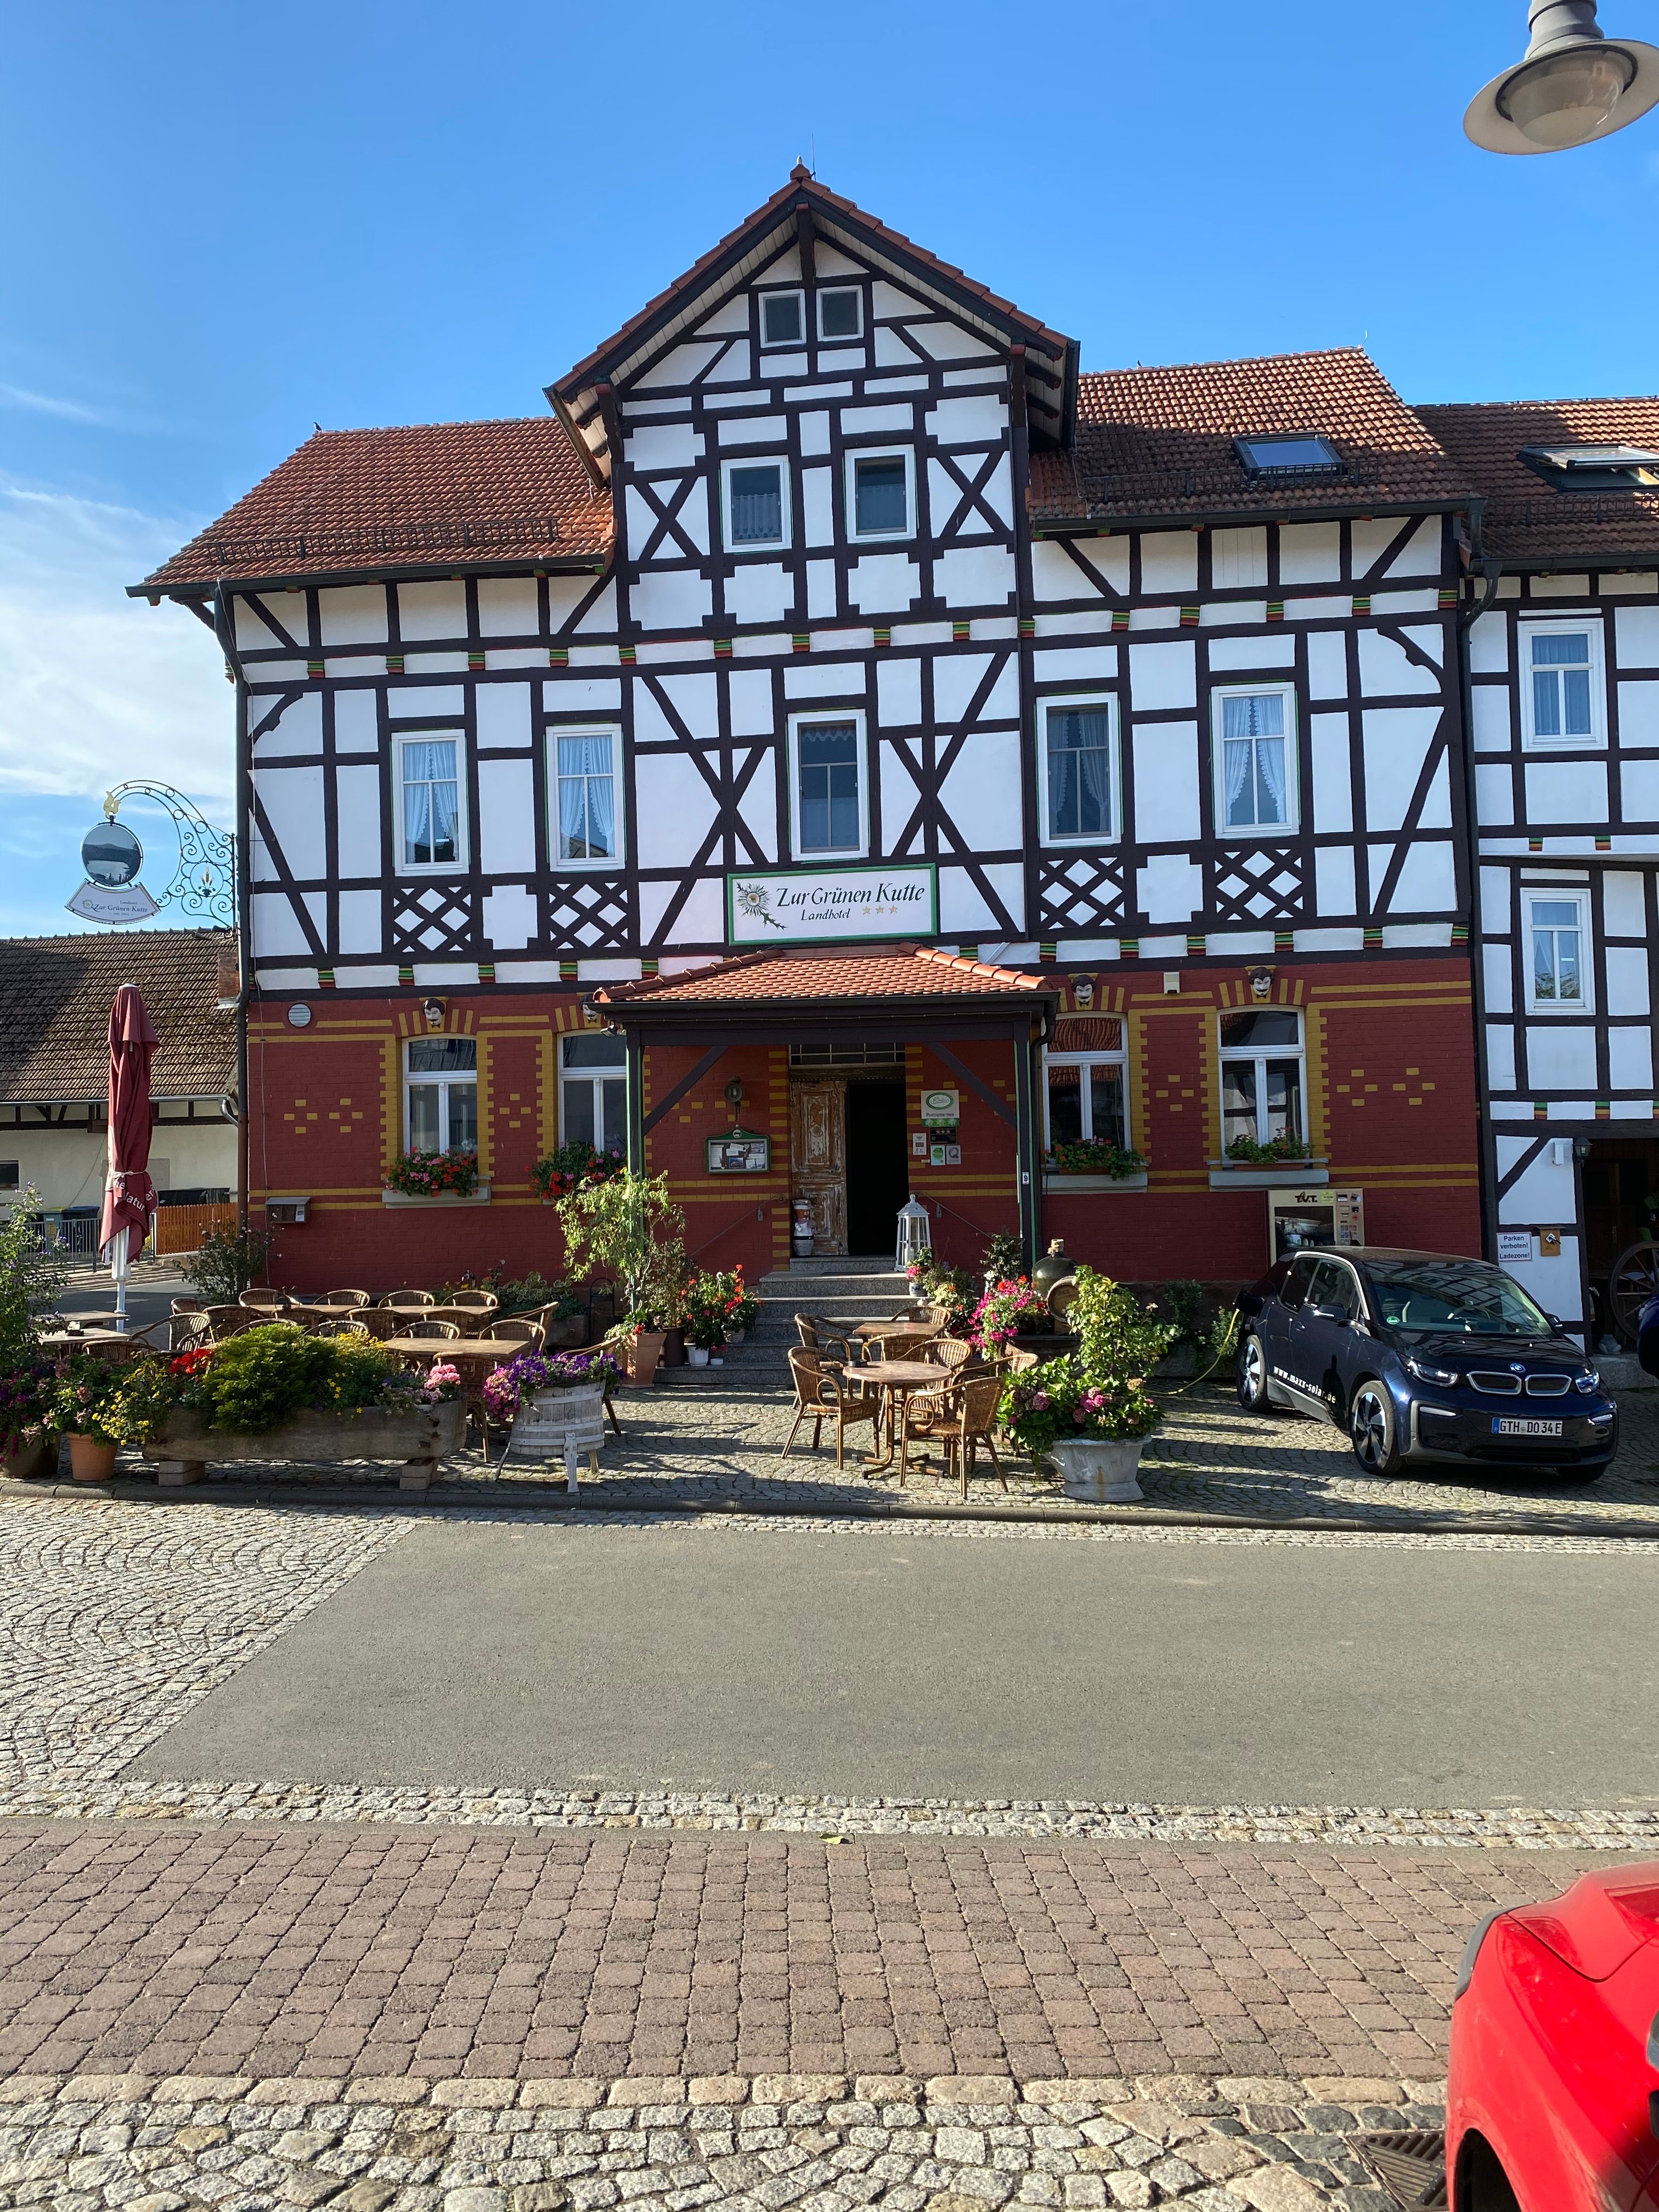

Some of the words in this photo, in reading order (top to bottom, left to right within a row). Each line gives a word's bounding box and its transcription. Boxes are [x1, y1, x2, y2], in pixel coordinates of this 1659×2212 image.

[776, 888, 810, 907] Zur
[811, 887, 872, 904] Grünen
[875, 883, 926, 902] Kutte
[801, 909, 851, 921] Landhotel
[1273, 1366, 1336, 1403] www.maxx-solar.de
[1500, 1421, 1520, 1432] GTH
[1527, 1421, 1539, 1433] DO
